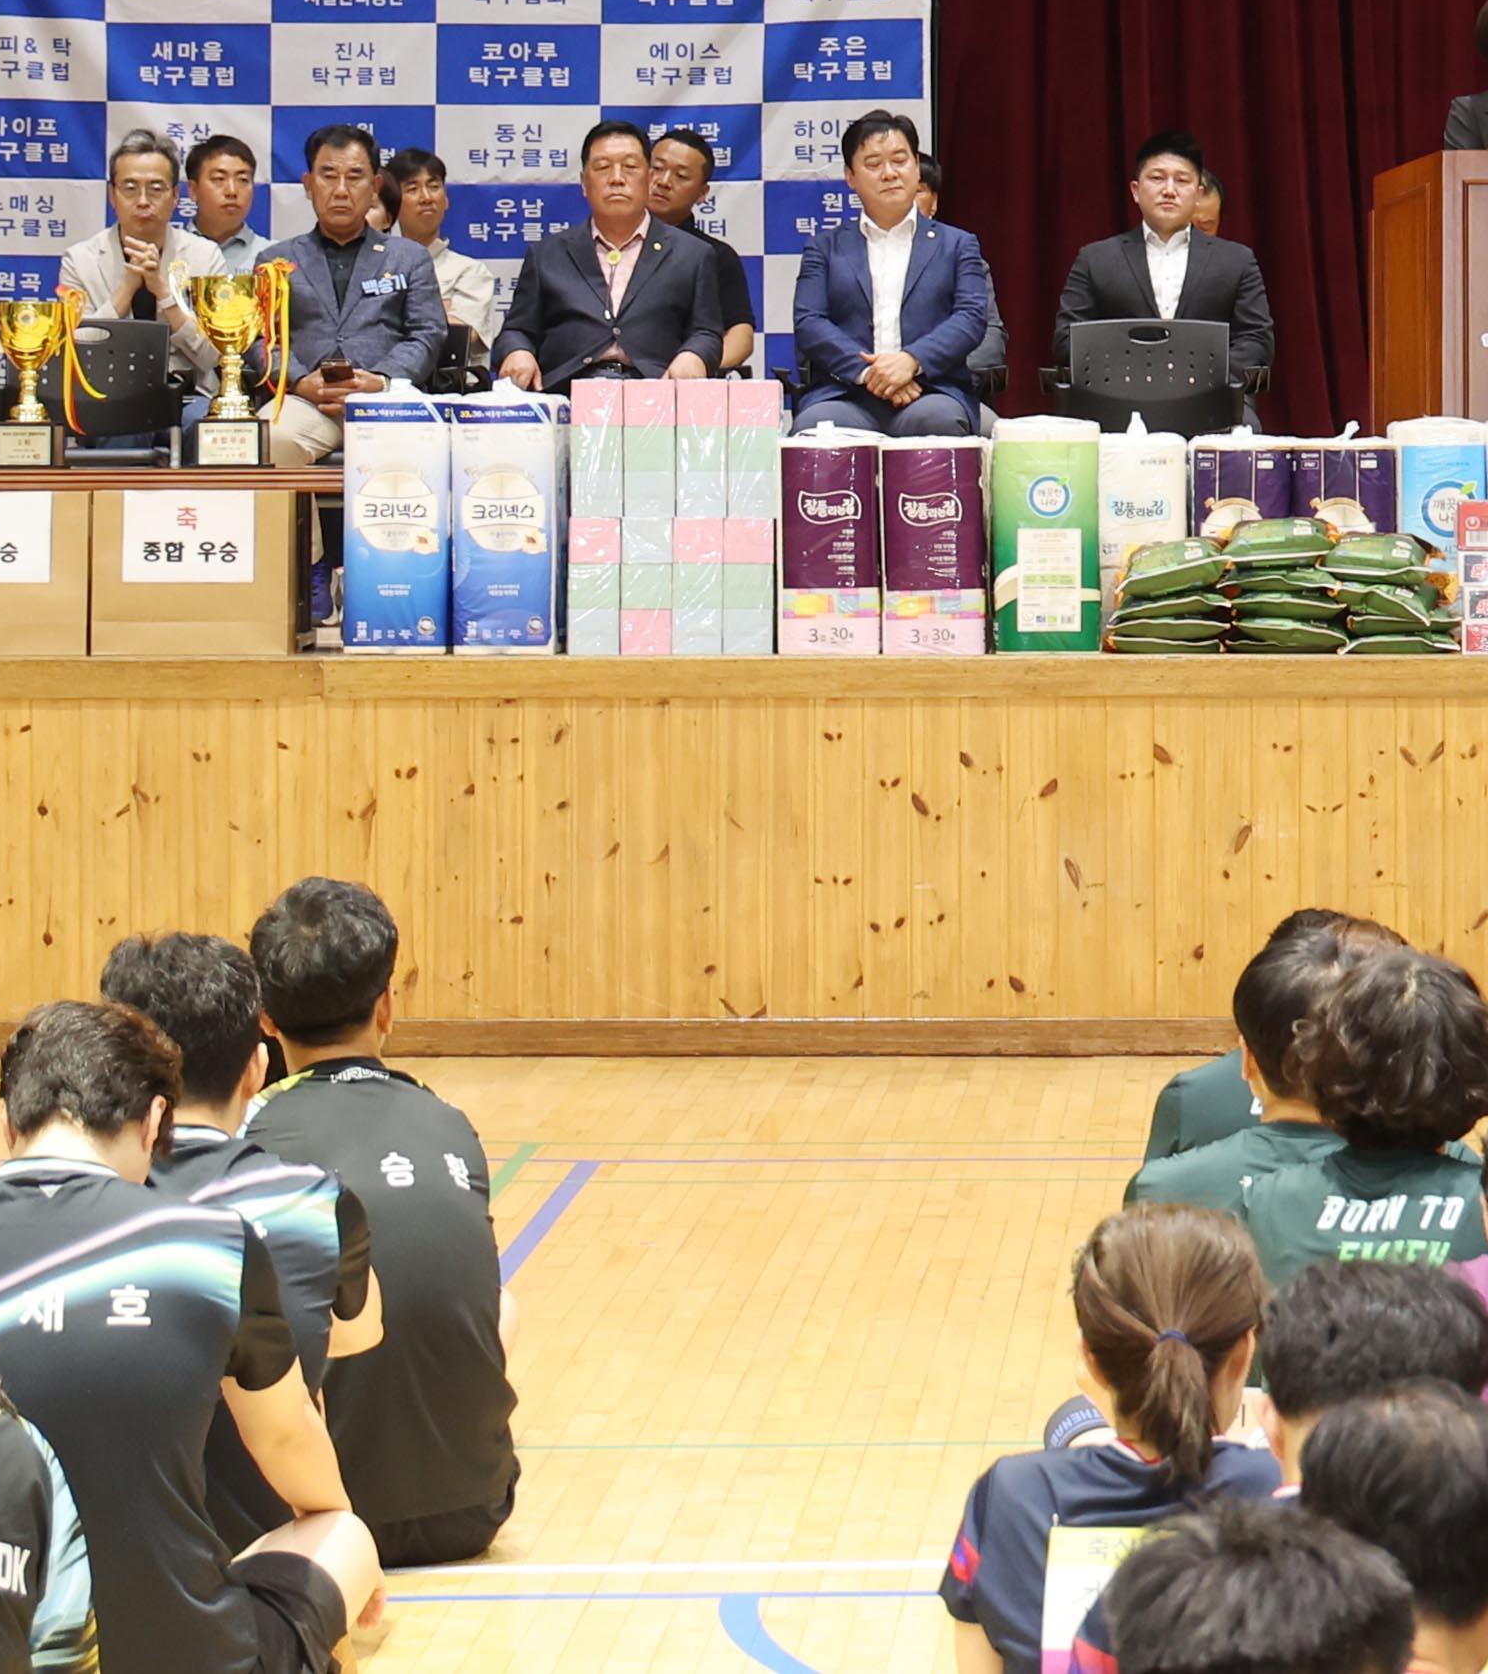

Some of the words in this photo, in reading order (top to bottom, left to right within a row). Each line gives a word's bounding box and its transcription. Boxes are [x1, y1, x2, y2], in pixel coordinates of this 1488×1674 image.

[53, 37, 72, 57] 탁
[152, 40, 224, 62] 새마을
[335, 41, 376, 61] 진사
[481, 41, 559, 63] 코아루
[649, 42, 721, 62] 에이스
[817, 35, 868, 57] 주은
[139, 65, 235, 87] 탁구클럽
[312, 65, 397, 87] 탁구클럽
[468, 66, 571, 88] 탁구클럽
[636, 64, 734, 87] 탁구클럽
[793, 58, 893, 82] 탁구클럽
[494, 123, 543, 144] 동신
[468, 148, 569, 169] 탁구클럽
[493, 198, 544, 220] 우남
[361, 499, 429, 521] 크리넥스
[470, 499, 536, 521] 크리넥스
[1432, 497, 1457, 511] 깨끗
[176, 505, 199, 532] 축
[141, 539, 184, 563] 종합
[197, 540, 240, 565] 우승
[1316, 1194, 1408, 1233] BORN
[1420, 1195, 1465, 1230] TO
[106, 1284, 152, 1327] 호
